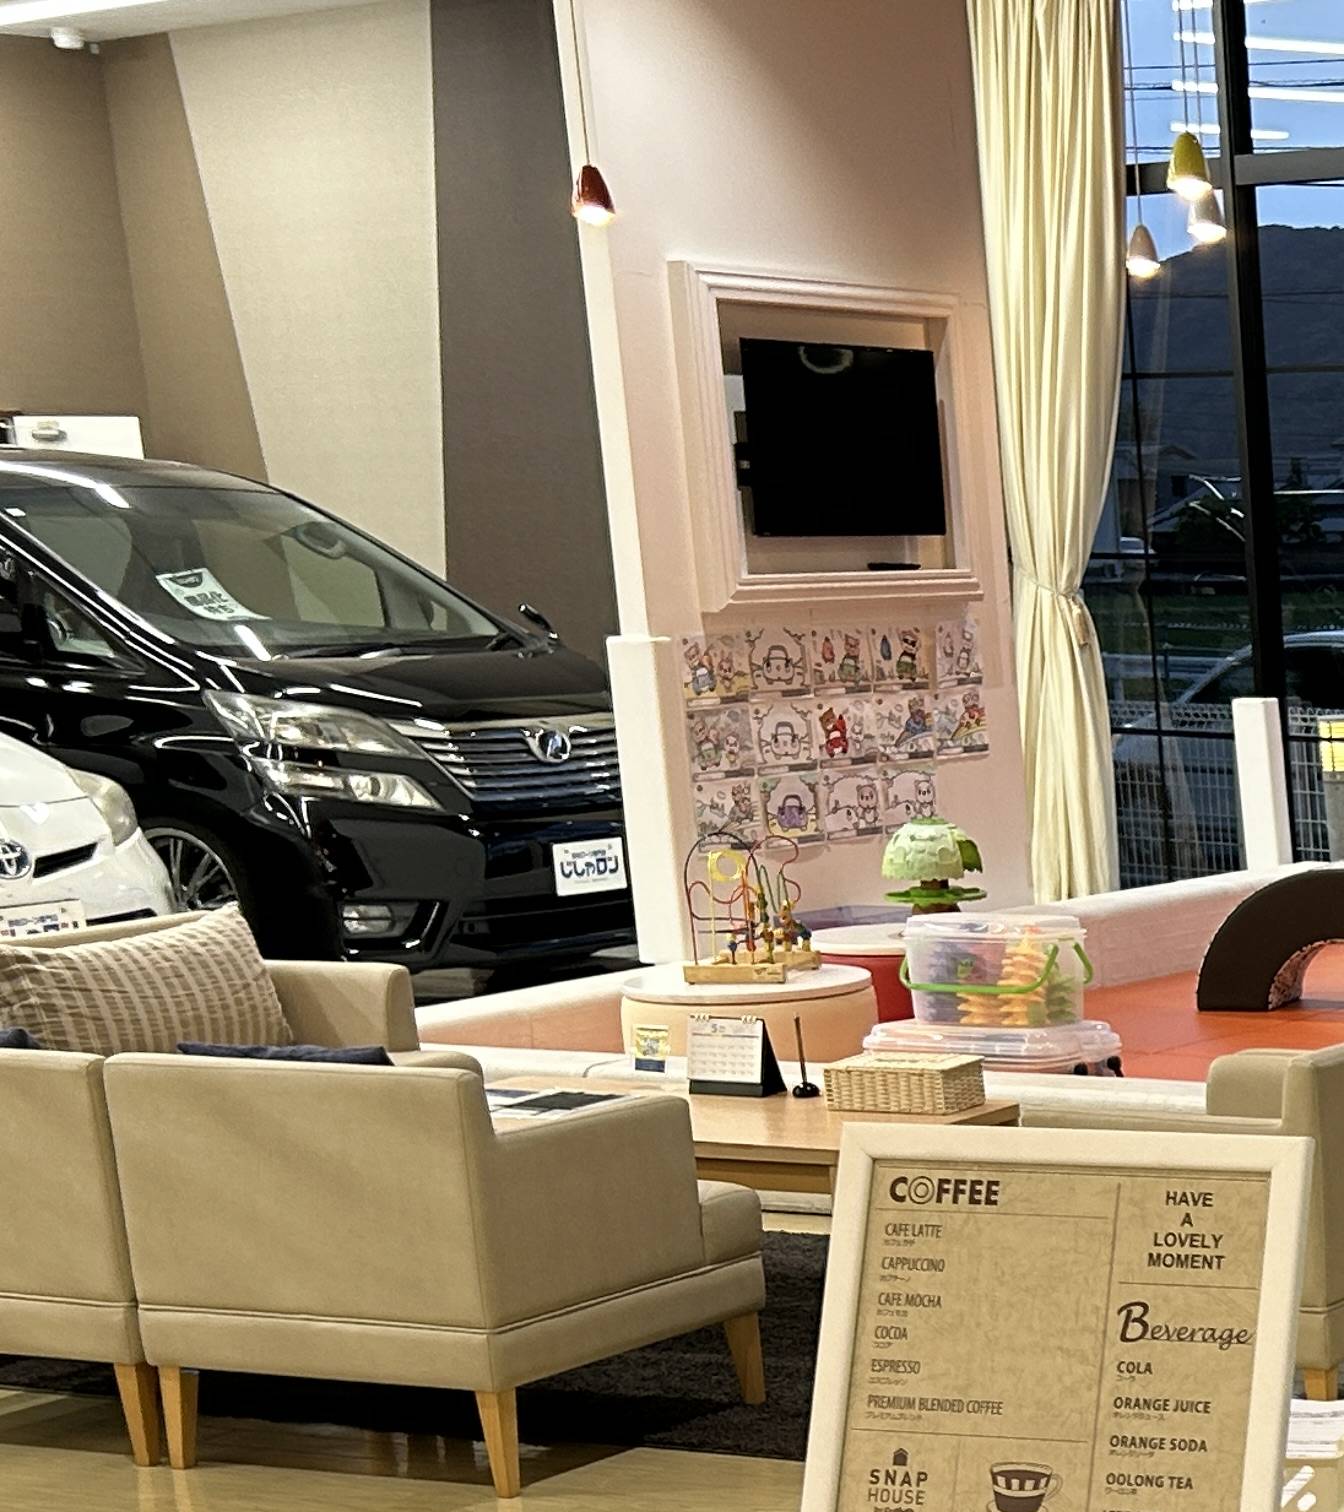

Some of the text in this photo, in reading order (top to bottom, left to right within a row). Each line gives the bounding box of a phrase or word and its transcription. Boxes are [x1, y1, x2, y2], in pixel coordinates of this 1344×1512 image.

[560, 855, 619, 878] じしゃロン
[889, 1176, 1000, 1206] COFFEE
[1165, 1190, 1214, 1208] HAVE
[1180, 1212, 1194, 1227] A
[911, 1223, 943, 1239] LATTE
[1153, 1232, 1224, 1249] LOVELY
[881, 1256, 945, 1273] CAPPUCCINO
[1147, 1252, 1226, 1270] MOMENT
[905, 1293, 942, 1308] MOCHA
[874, 1325, 908, 1341] COCOA
[1117, 1301, 1253, 1351] Beverage
[871, 1358, 921, 1374] ESPRESSO
[1116, 1360, 1153, 1375] COLA
[867, 1394, 1003, 1416] PREMIUM BLENDED COFFEE
[1113, 1397, 1211, 1414] ORANGE JUICE
[1109, 1434, 1208, 1452] ORANGE SODA
[869, 1468, 928, 1486] SNAP
[1106, 1472, 1193, 1490] OOLONG TEA
[867, 1487, 926, 1506] HOUSE
